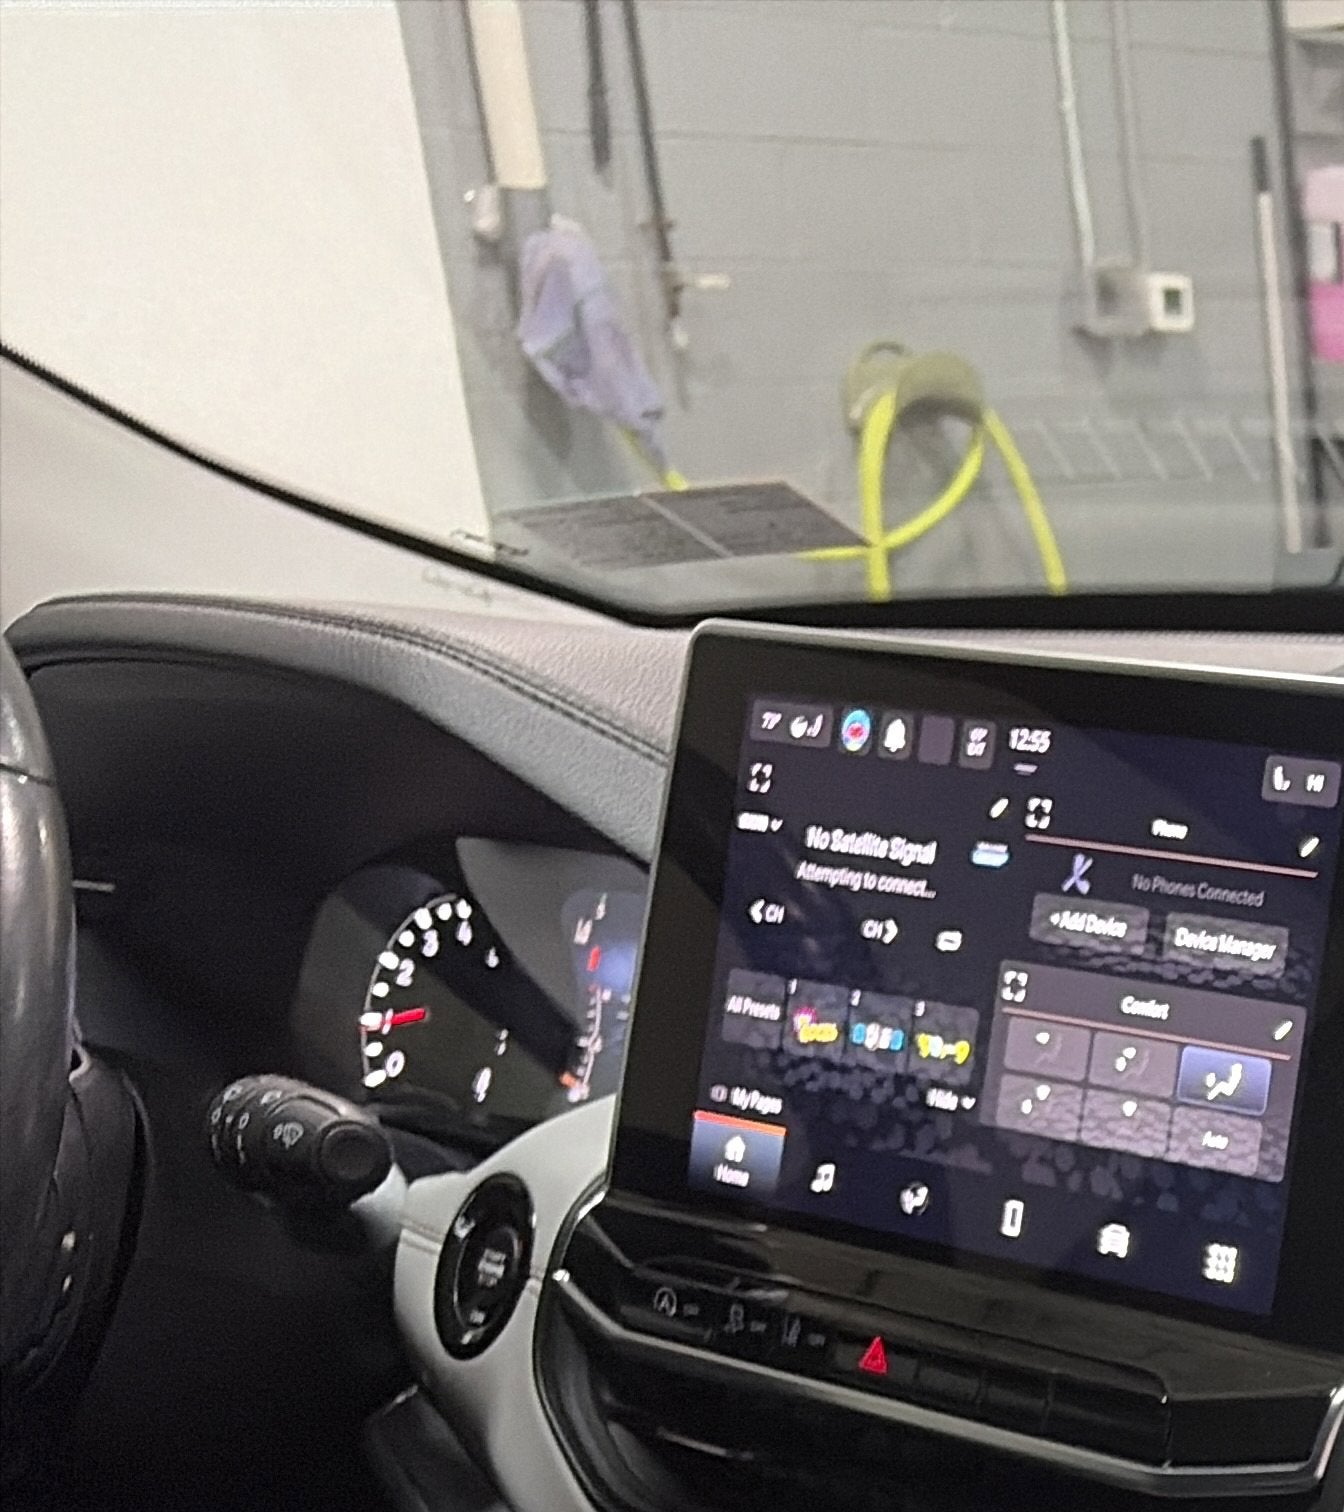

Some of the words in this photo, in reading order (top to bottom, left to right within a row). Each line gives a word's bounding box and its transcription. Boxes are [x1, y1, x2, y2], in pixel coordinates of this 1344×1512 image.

[805, 825, 831, 850] No
[830, 829, 889, 859] Satellite
[889, 836, 938, 867] Signal
[795, 860, 862, 892] Attempting
[862, 872, 877, 890] to
[1132, 873, 1151, 892] No
[1151, 875, 1197, 898] Phones
[1197, 881, 1265, 908] Connected
[765, 903, 785, 924] CH
[421, 928, 440, 958] 3
[861, 918, 884, 940] CH
[1174, 926, 1219, 952] Device
[395, 957, 416, 988] 2
[385, 1049, 406, 1079] 0
